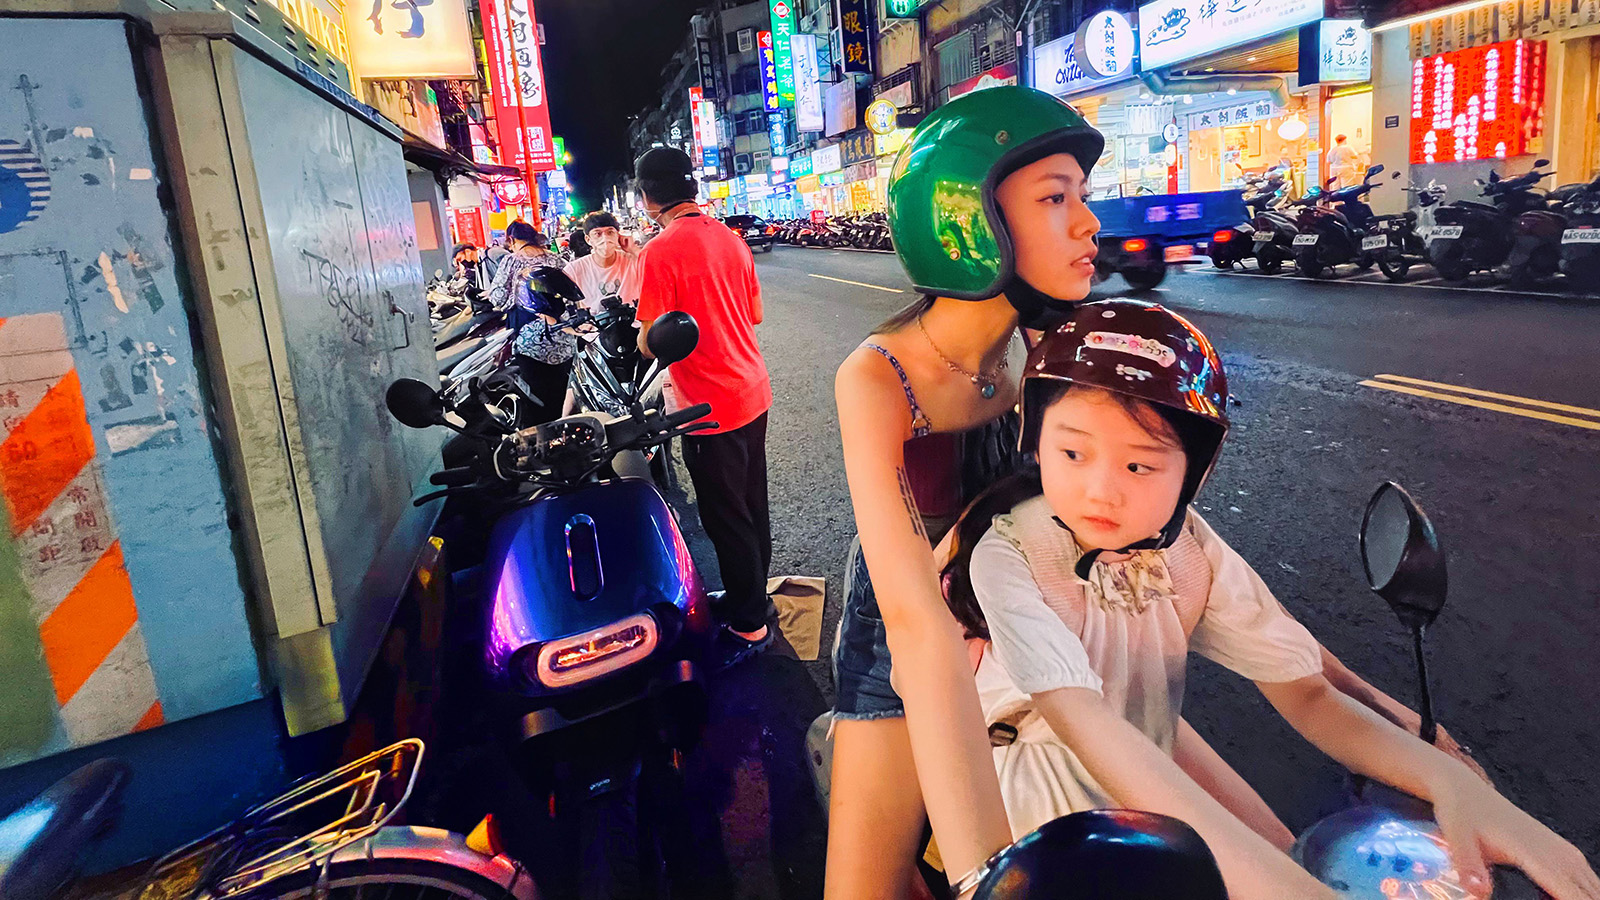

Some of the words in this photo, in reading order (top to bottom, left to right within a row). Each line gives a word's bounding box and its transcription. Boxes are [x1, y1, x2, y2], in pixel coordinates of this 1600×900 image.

[843, 0, 867, 65] 眼鏡
[1200, 104, 1270, 126] 太朗飯糰
